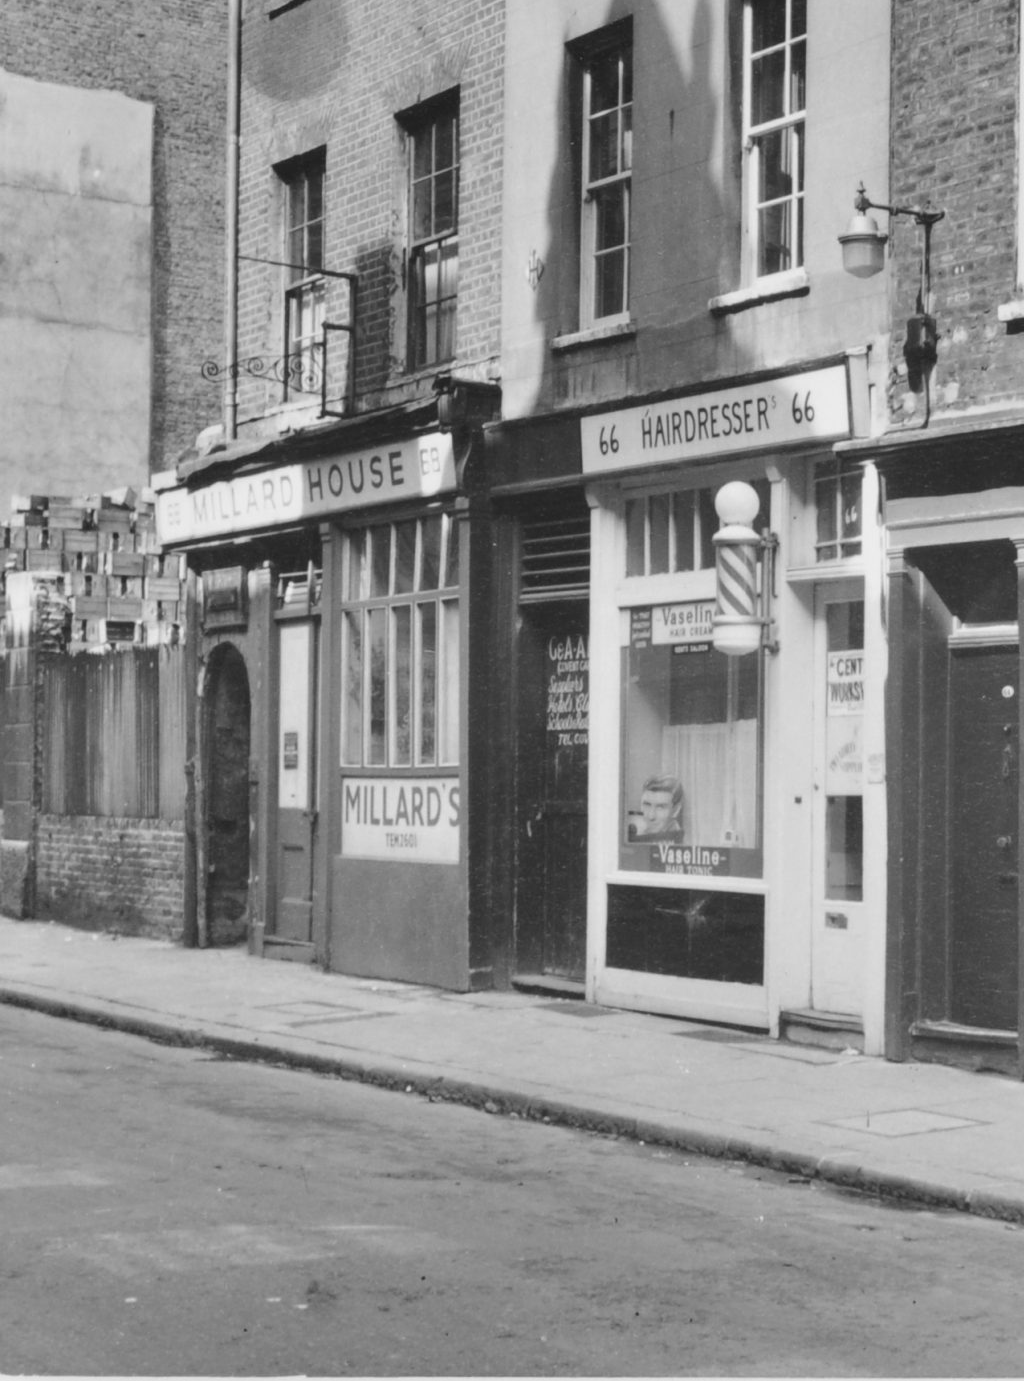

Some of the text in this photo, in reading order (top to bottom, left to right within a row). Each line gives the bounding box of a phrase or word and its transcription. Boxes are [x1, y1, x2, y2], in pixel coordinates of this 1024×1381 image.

[600, 424, 620, 456] 66
[792, 390, 816, 425] 66
[192, 475, 295, 525] MILLARD
[308, 451, 405, 502] HOUSE
[662, 604, 714, 626] Vaselin
[670, 627, 686, 638] HAIR
[345, 783, 460, 828] MILLARD'S
[665, 865, 684, 875] HAIR
